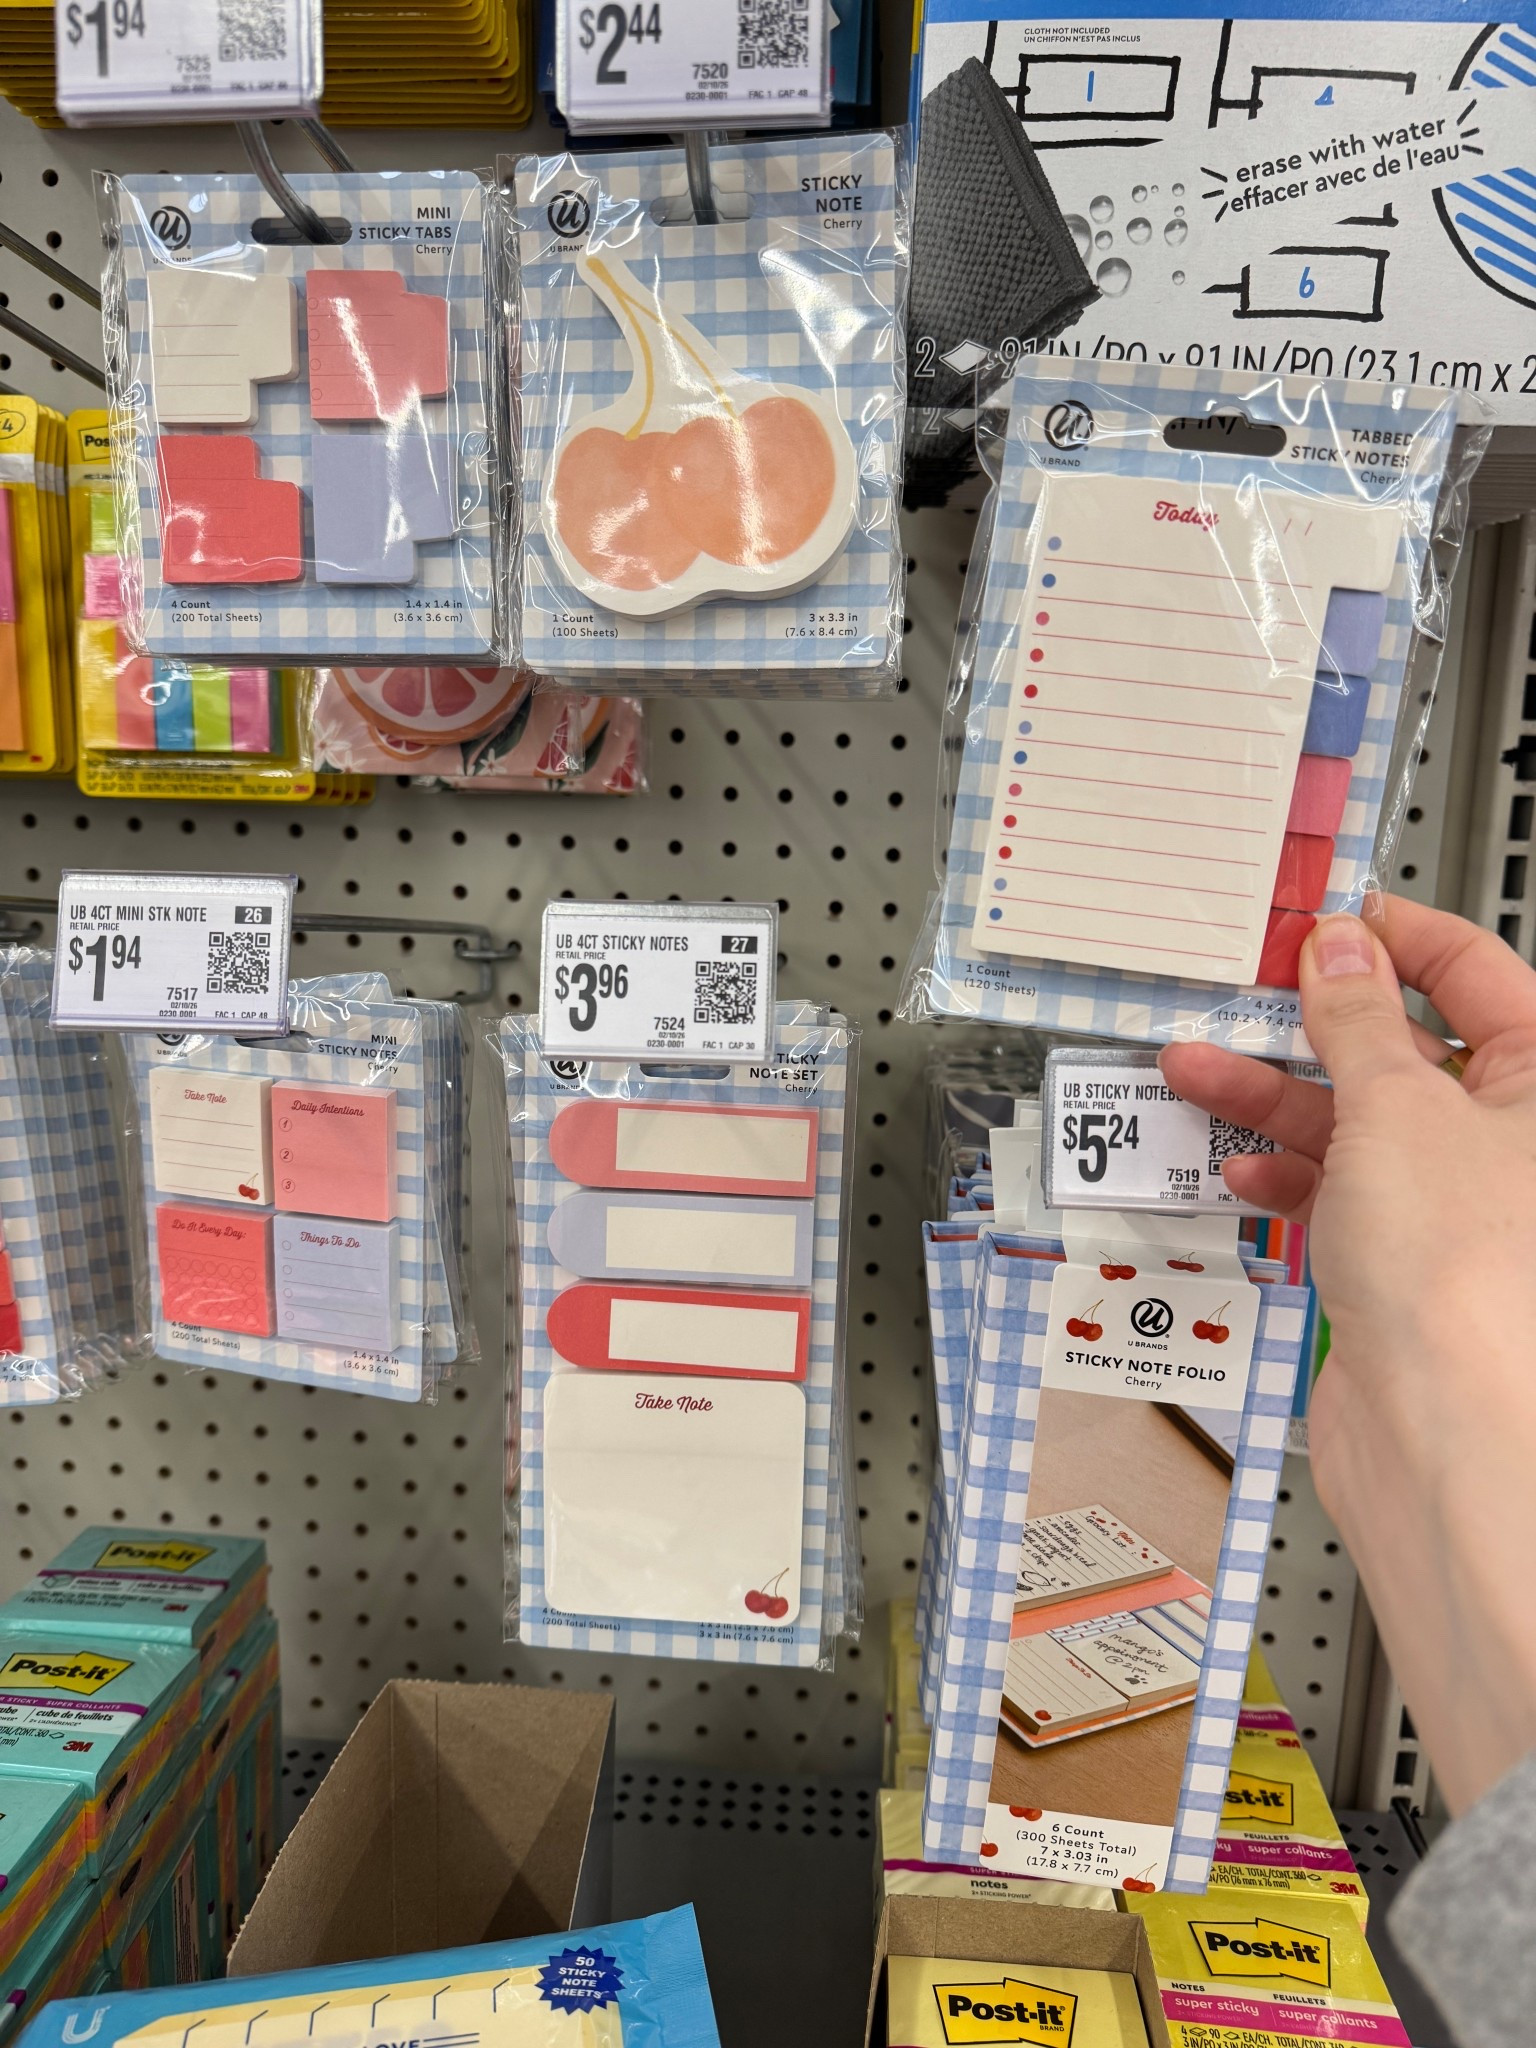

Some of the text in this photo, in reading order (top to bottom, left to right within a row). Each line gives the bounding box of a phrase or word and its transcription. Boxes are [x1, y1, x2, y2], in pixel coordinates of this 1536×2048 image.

[1052, 27, 1069, 35] NOT
[1070, 27, 1110, 35] INCLUDED
[1036, 35, 1071, 43] CHIFFON
[1072, 35, 1096, 43] N'EST
[1112, 35, 1141, 43] INCLUS
[692, 63, 729, 80] 7520
[1236, 118, 1446, 183] erase with water
[801, 174, 862, 193] STICKY
[1230, 144, 1460, 213] effacer avec de l'eau
[815, 196, 862, 213] NOTE
[417, 207, 451, 219] MINI
[823, 217, 863, 231] Cherry
[359, 226, 452, 240] STICKY TABS
[416, 244, 453, 256] Cherry
[1430, 360, 1482, 392] cm
[1352, 429, 1414, 446] TABBED
[1355, 451, 1410, 468] NOTES
[1154, 501, 1219, 532] Today
[181, 601, 211, 609] Count
[171, 613, 263, 624] (200 Total Sheets)
[393, 613, 463, 623] (3.6 cm)
[562, 614, 594, 623] Count
[552, 627, 619, 638] (100 Sheets)
[838, 627, 858, 638] cm)
[70, 905, 263, 923] UB 4CT MINI STK NOTE 26
[70, 922, 120, 931] RETAIL PRICE
[556, 934, 748, 952] UB 4CT STICKY NOTES 27
[556, 951, 606, 960] RETAIL PRICE
[976, 965, 1011, 979] Count
[167, 987, 198, 1001] 7517
[963, 977, 1037, 998] (120 Sheets)
[1217, 1010, 1249, 1023] (10.2
[654, 1017, 685, 1031] 7524
[371, 1034, 397, 1045] MINI
[318, 1043, 398, 1059] STICKY NOTES
[367, 1061, 399, 1074] Cherry
[750, 1067, 818, 1081] NOTE SET
[785, 1083, 818, 1094] Cherry
[1063, 1083, 1080, 1099] UB
[1085, 1084, 1130, 1100] STICKY
[184, 1088, 227, 1104] Take Note
[291, 1100, 365, 1118] Daily Intentions
[1063, 1100, 1116, 1110] RETAIL PRICE
[1167, 1168, 1200, 1182] 7519
[1160, 1191, 1199, 1201] 0230-0001
[1218, 1193, 1233, 1202] FAC
[198, 1222, 222, 1237] Every
[300, 1231, 361, 1249] Things To Do
[1135, 1342, 1169, 1350] BRANDS
[1065, 1351, 1227, 1382] STICKY NOTE FOLIO
[1124, 1375, 1163, 1390] Cherry
[635, 1392, 713, 1414] Take Note
[110, 1545, 196, 1563] Post-it
[565, 1619, 621, 1632] Total Sheets)
[9, 1659, 110, 1681] Post-it
[7, 1696, 38, 1704] STICKY
[46, 1700, 74, 1708] SUPER
[36, 1710, 114, 1721] cube de feuillets
[62, 1741, 95, 1752] 3M
[1275, 1737, 1300, 1748] 3M
[1064, 1825, 1105, 1839] Count
[1244, 1832, 1290, 1841] FEUILLETS
[1016, 1829, 1137, 1857] (300 Sheets Total)
[1063, 1849, 1109, 1864] 3.03 in
[1248, 1844, 1333, 1860] super collants
[1026, 1855, 1119, 1879] (17.8 7.7 cm)
[1218, 1865, 1292, 1880] EA/CH. TOTAL/CONT.
[970, 1879, 1009, 1890] notes
[1329, 1881, 1360, 1896] 3M
[1204, 1931, 1321, 1965] Post-it
[575, 1956, 595, 1967] 50
[558, 1967, 606, 1978] STICKY
[562, 1978, 598, 1988] NOTE
[1171, 1982, 1206, 1992] NOTES
[551, 1987, 603, 1999] SHEETS
[1272, 1993, 1327, 2006] FEUILLETS
[948, 1994, 1064, 2026] Post-it
[1175, 1996, 1260, 2017] super sticky
[1278, 2008, 1317, 2022] super
[1320, 2011, 1378, 2030] collants
[1243, 2032, 1274, 2046] EA/CH.
